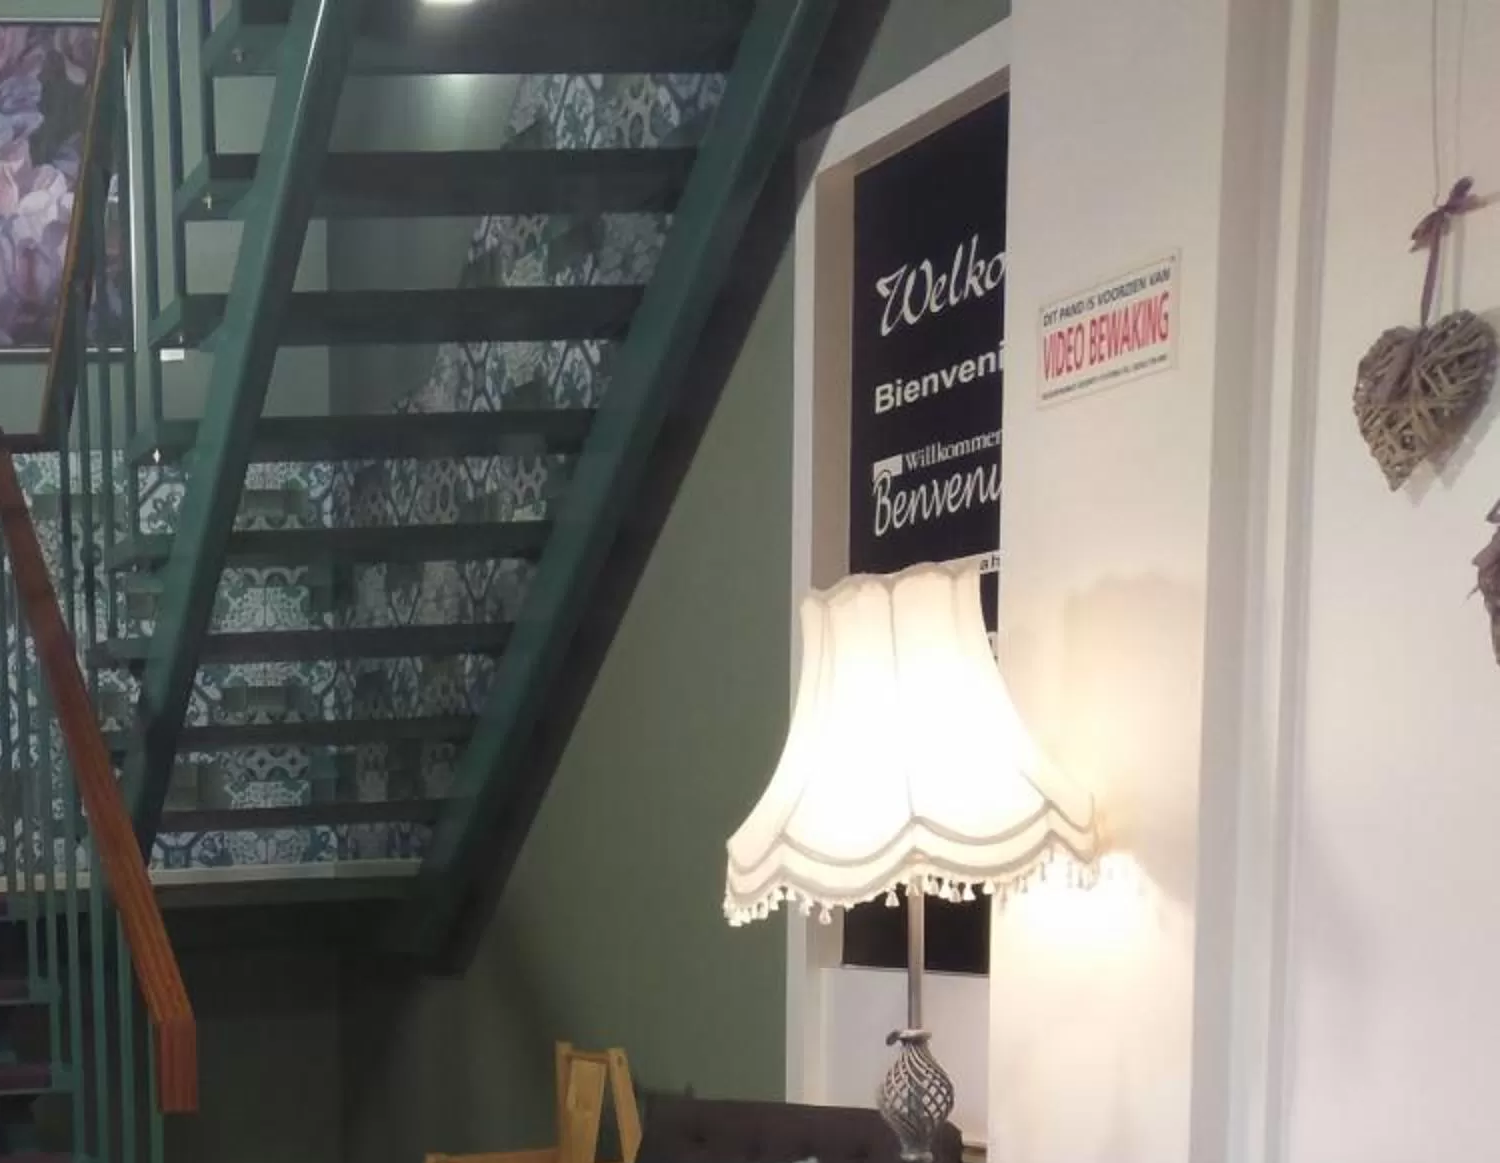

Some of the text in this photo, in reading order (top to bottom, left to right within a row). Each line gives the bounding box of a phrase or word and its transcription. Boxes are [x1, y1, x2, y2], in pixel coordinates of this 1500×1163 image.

[1043, 309, 1058, 327] DIT
[1059, 300, 1085, 321] PAND
[1086, 296, 1095, 311] IS
[1149, 267, 1171, 286] VAN
[1043, 322, 1085, 382] VIDEO
[1089, 290, 1170, 366] BEWAKING
